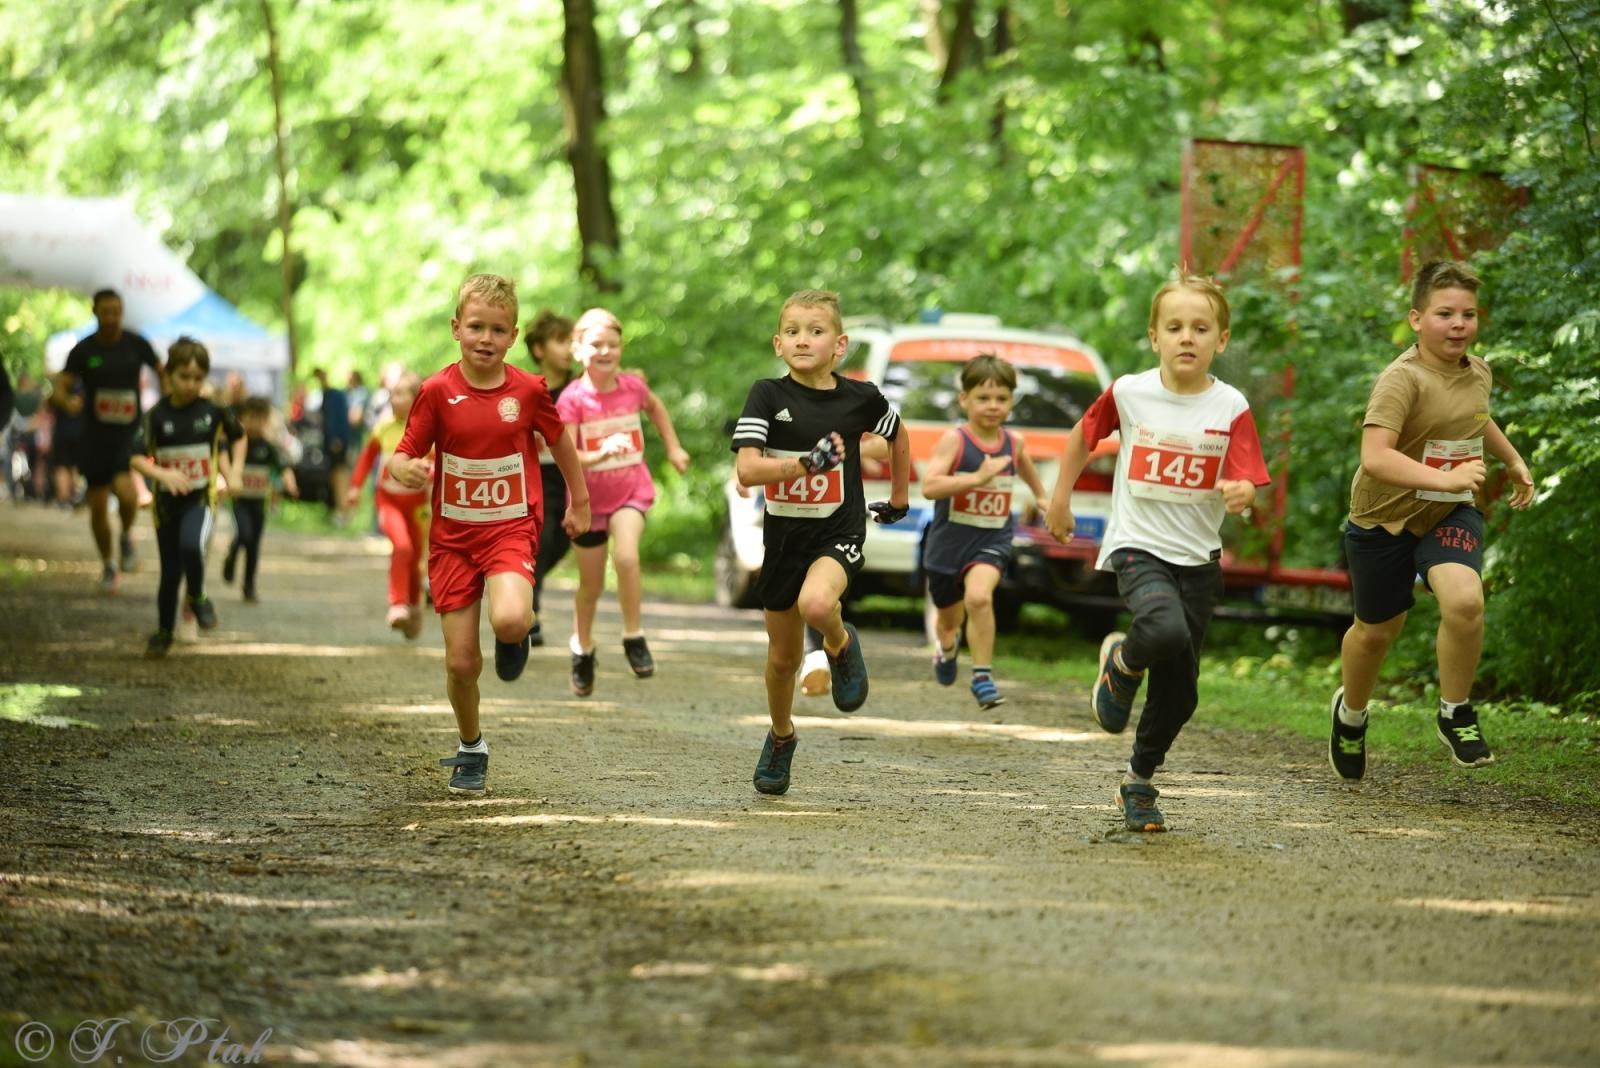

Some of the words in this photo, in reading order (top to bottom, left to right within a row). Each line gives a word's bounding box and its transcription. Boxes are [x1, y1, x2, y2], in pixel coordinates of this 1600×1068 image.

[497, 464, 514, 473] 4500
[1144, 451, 1207, 487] 145
[455, 479, 511, 507] 140
[774, 474, 829, 502] 149
[965, 492, 1006, 515] 160
[1441, 537, 1473, 553] NEW
